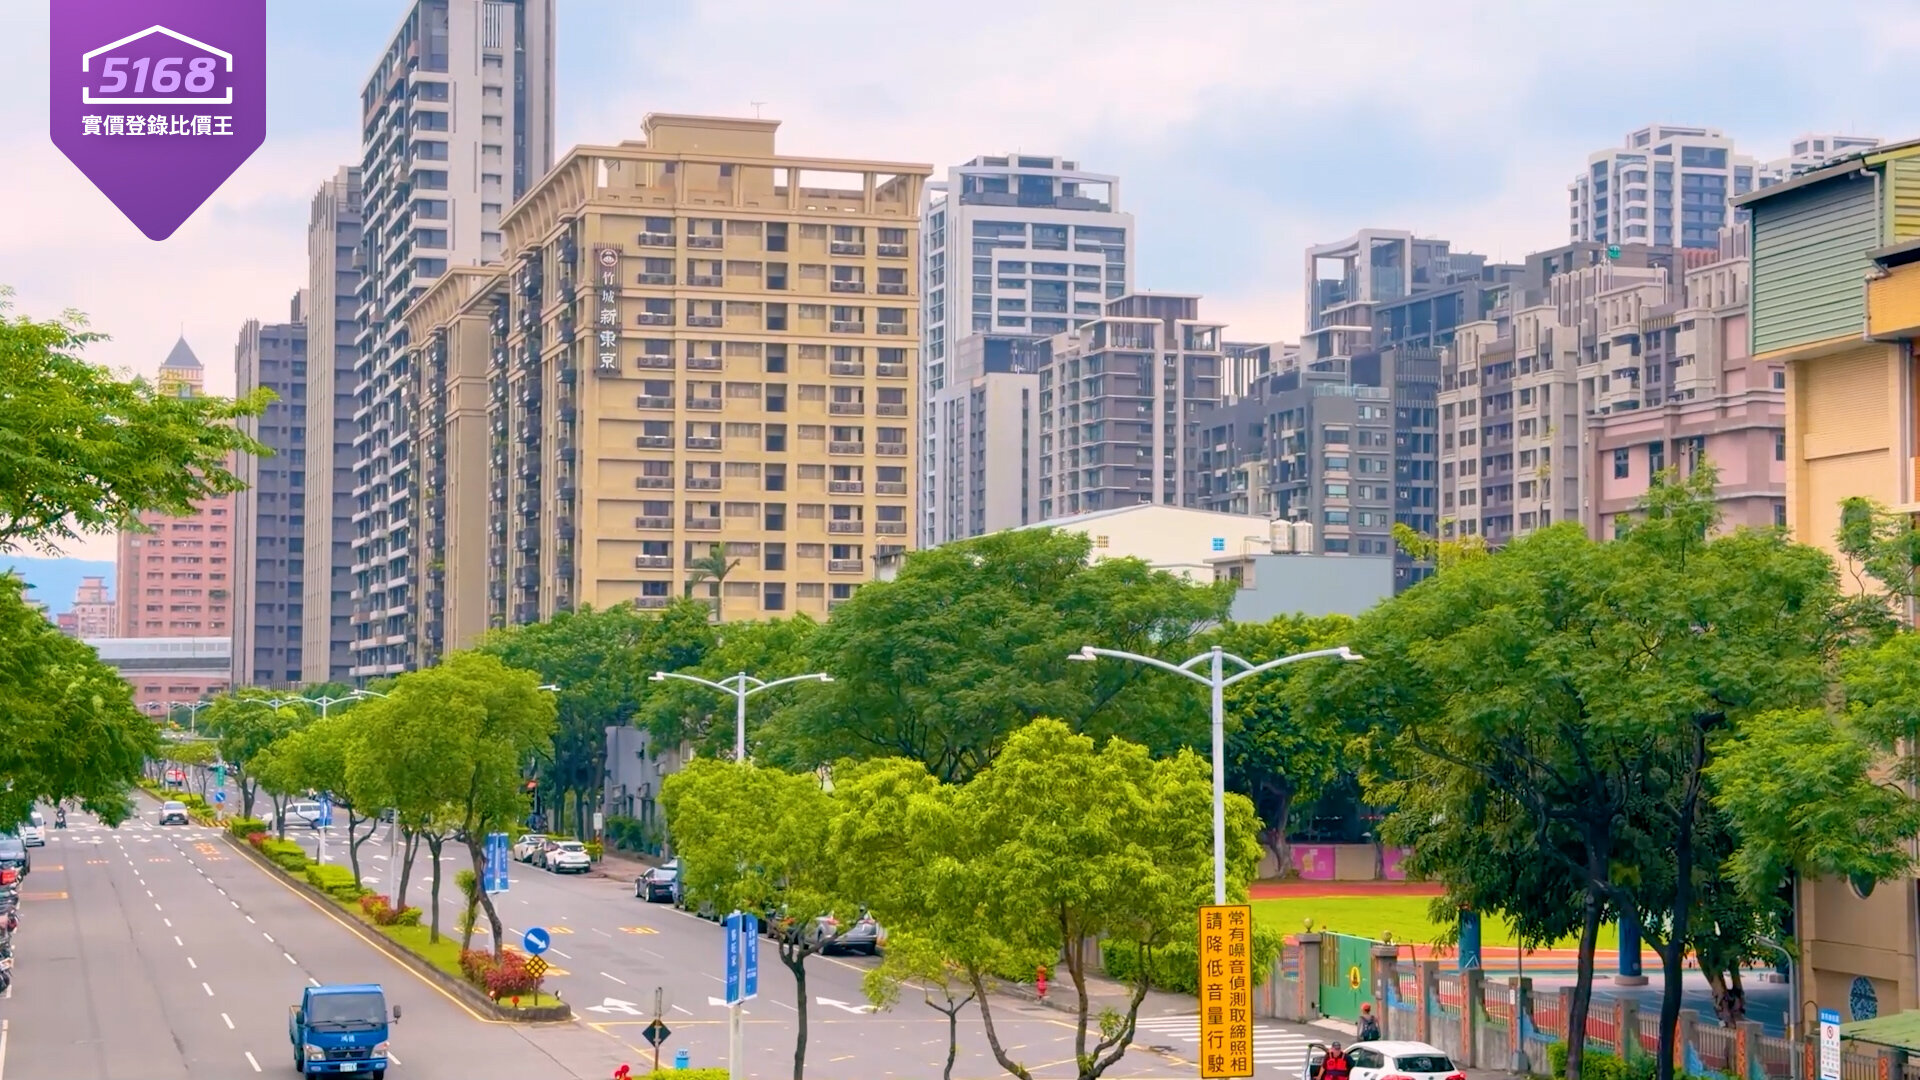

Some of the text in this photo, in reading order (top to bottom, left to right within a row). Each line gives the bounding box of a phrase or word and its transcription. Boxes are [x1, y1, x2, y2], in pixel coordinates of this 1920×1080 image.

[600, 271, 617, 369] 竹城新東京
[1206, 912, 1225, 1073] 請降低音量行駛
[1228, 911, 1247, 1072] 常有噪音偵測取締照相
